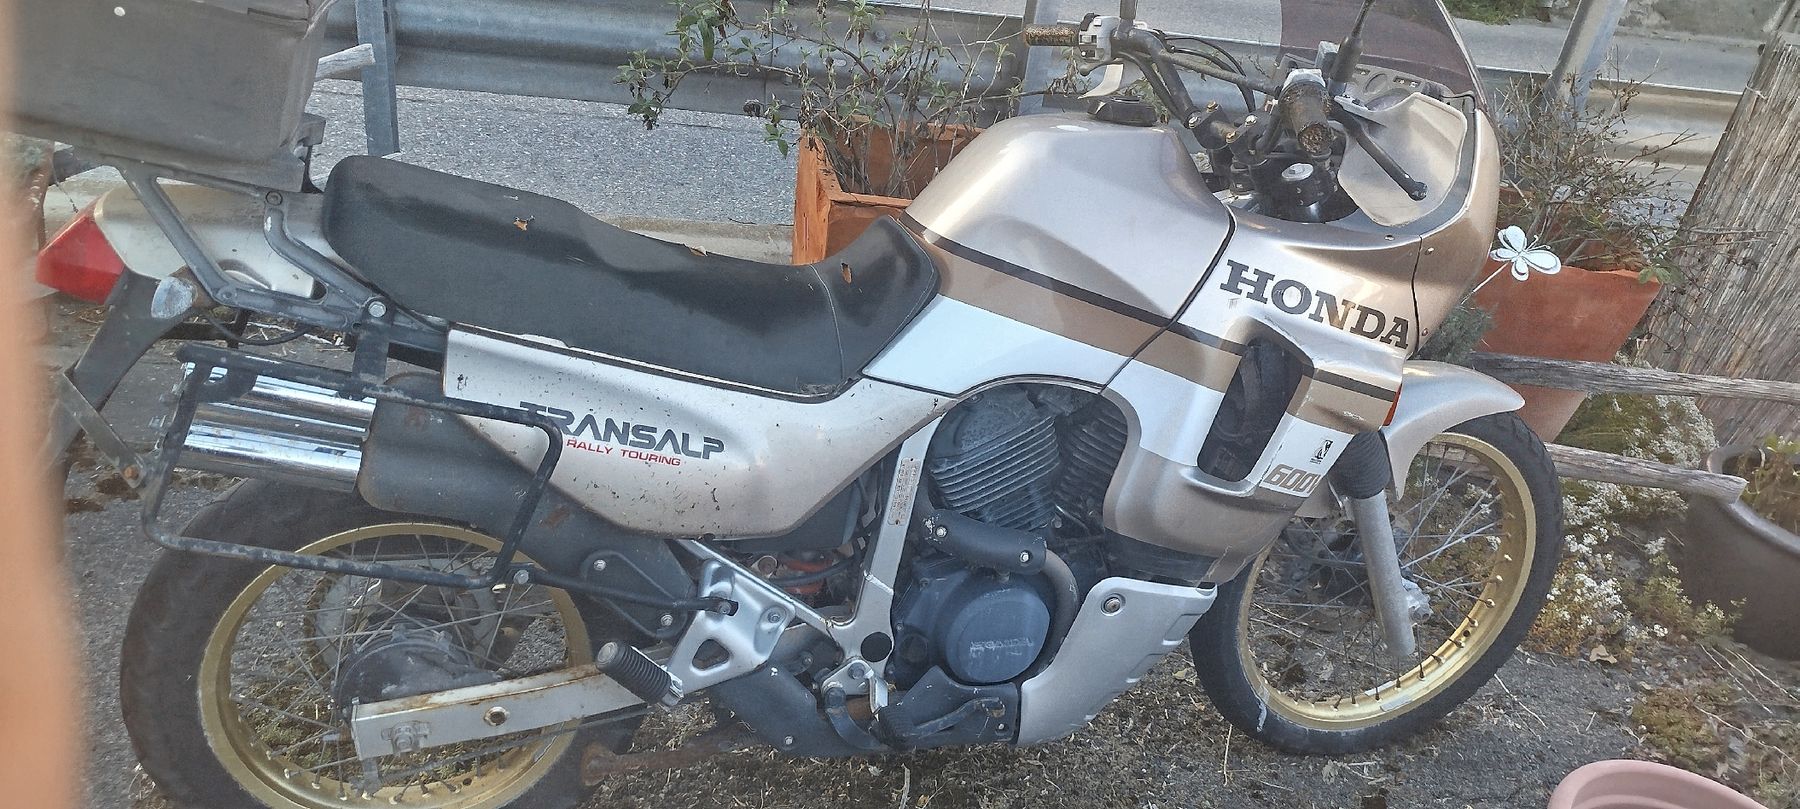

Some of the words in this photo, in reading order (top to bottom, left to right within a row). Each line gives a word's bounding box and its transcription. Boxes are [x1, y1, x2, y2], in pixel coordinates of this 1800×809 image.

[1219, 259, 1409, 349] HONDA
[519, 400, 725, 460] TRANSALP
[566, 437, 613, 455] RALLY
[620, 448, 681, 467] TOURING
